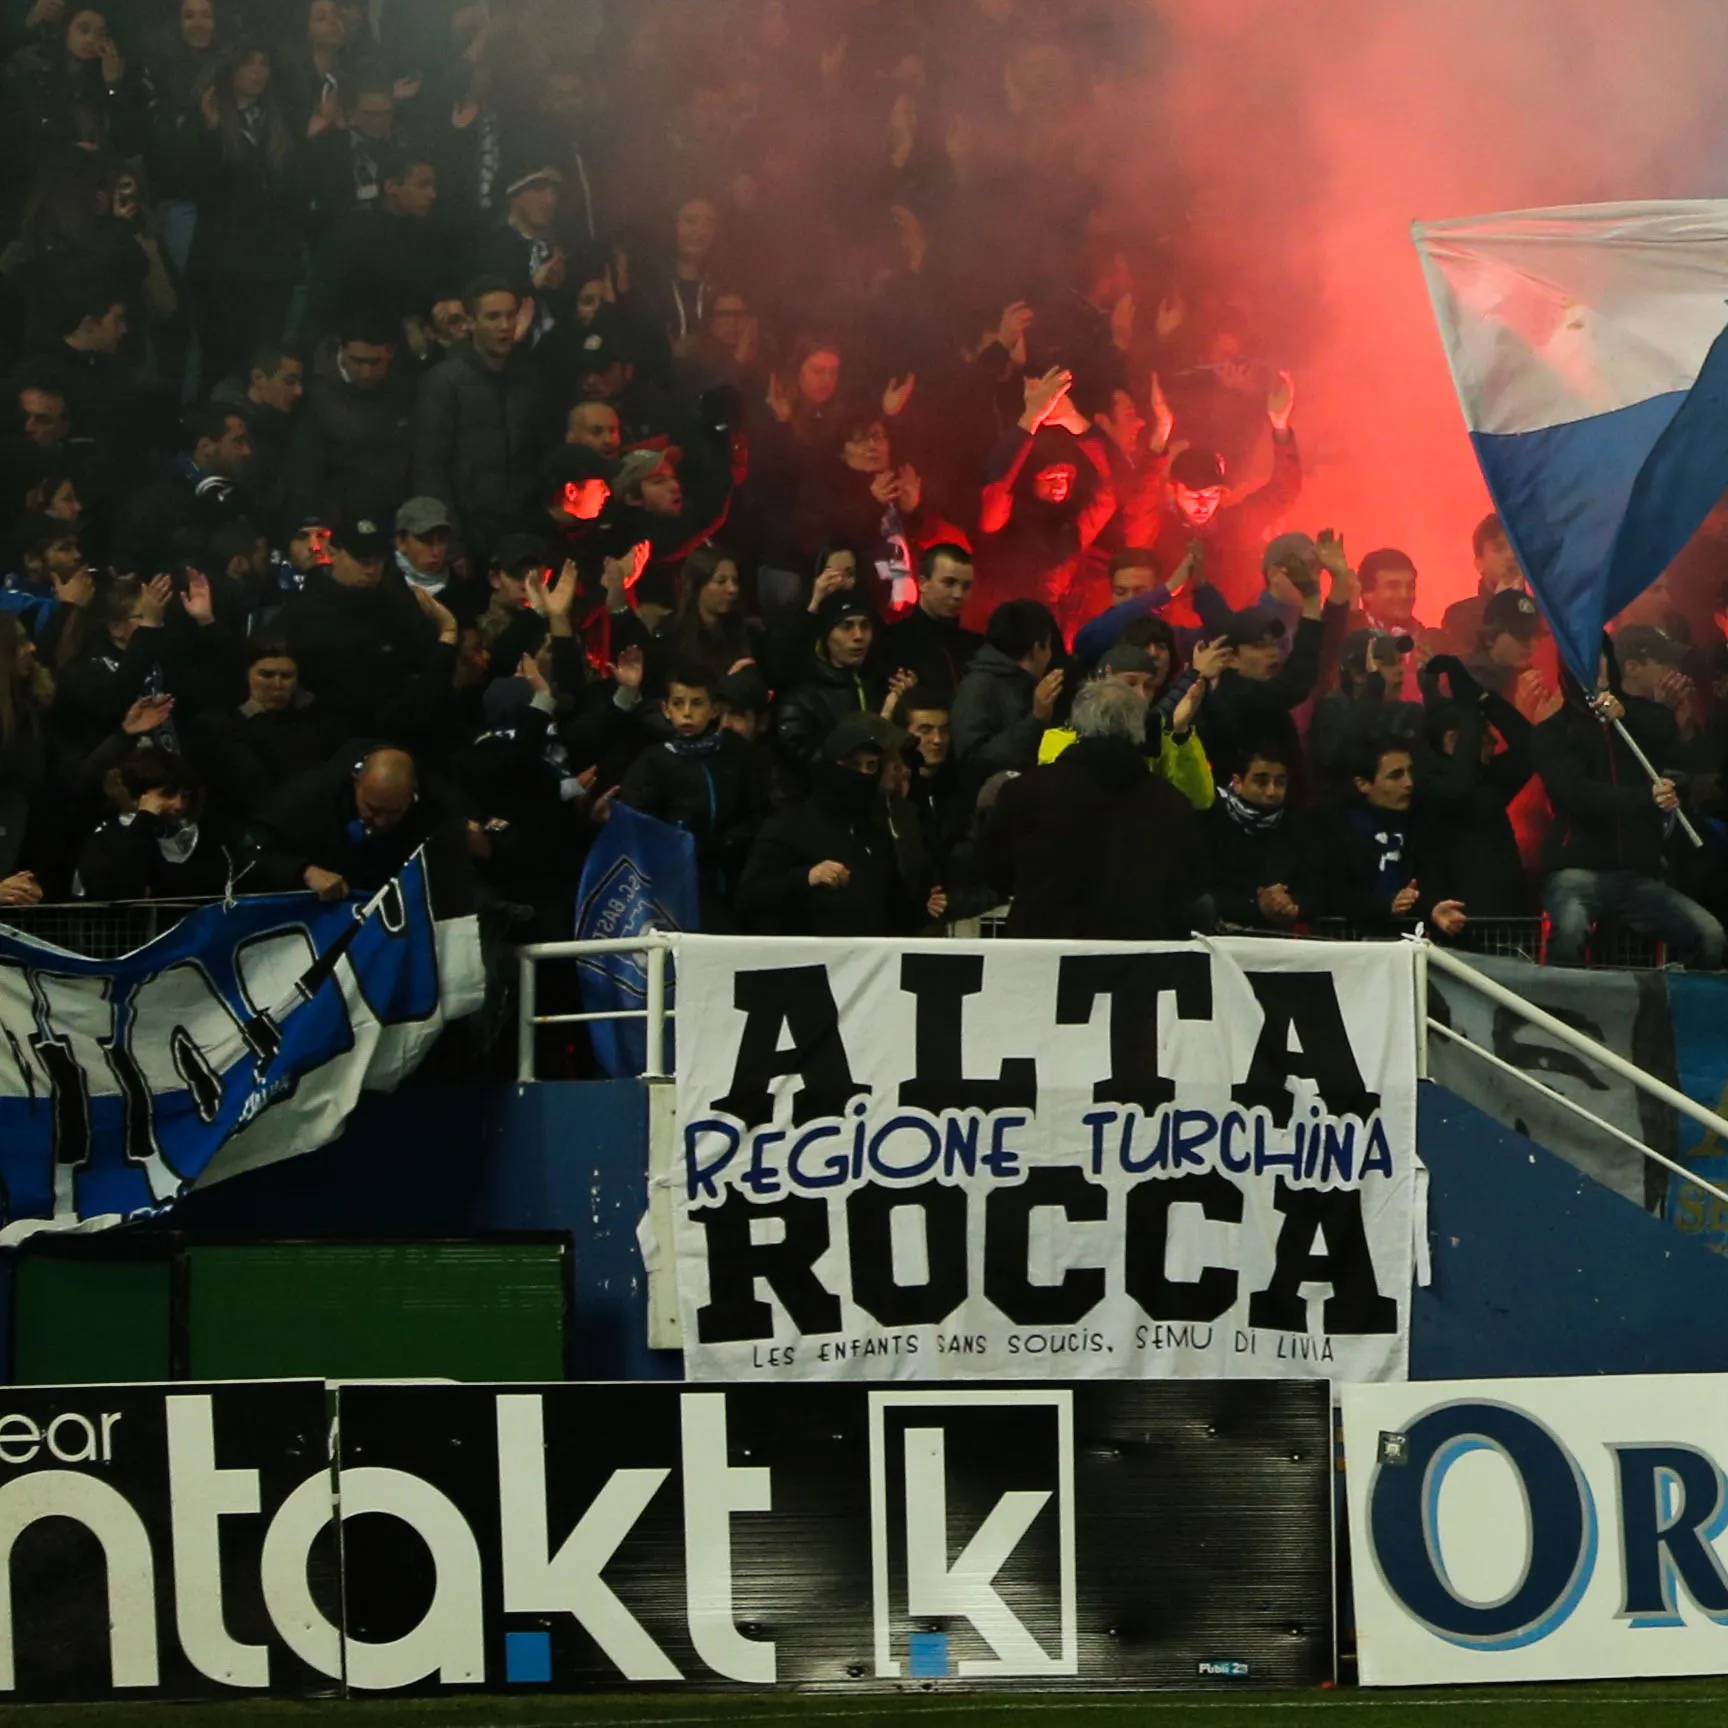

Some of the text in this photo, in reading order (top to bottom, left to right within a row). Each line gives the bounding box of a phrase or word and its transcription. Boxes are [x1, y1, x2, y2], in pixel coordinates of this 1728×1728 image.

[710, 951, 1382, 1129] ALTA
[684, 1104, 1028, 1201] REGiONE
[688, 1167, 1399, 1344] ROCCA
[753, 1346, 795, 1368] LES
[817, 1333, 920, 1362] ENFANTS
[937, 1332, 988, 1356] SANS
[1135, 1323, 1213, 1352] SEMU
